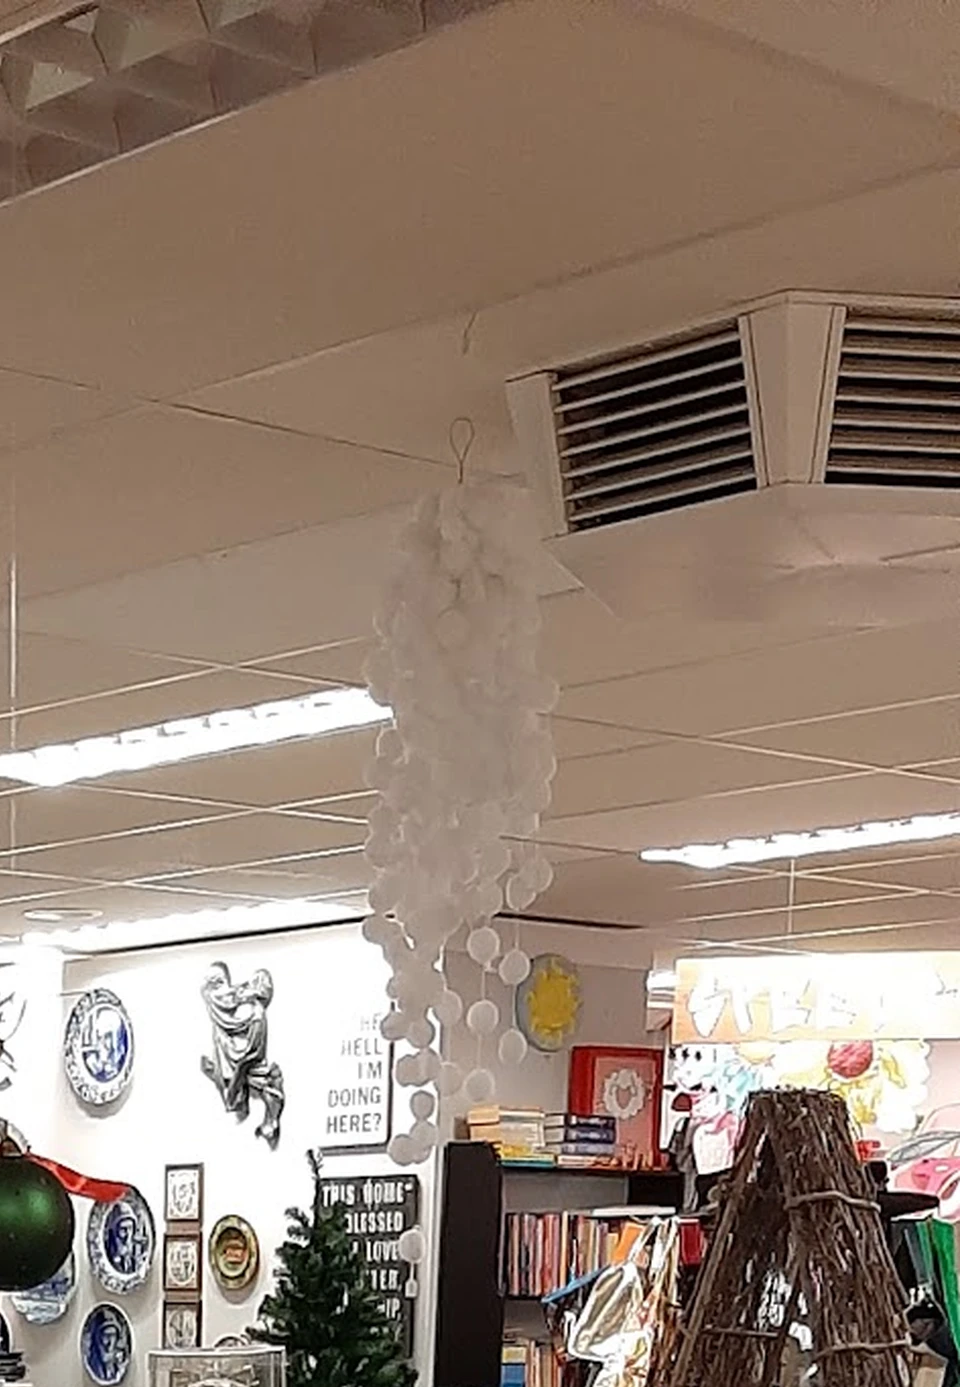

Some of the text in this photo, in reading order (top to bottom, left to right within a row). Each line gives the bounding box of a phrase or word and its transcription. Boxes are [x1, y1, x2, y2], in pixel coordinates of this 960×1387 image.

[341, 1037, 383, 1056] HELL
[327, 1086, 382, 1108] DOING
[325, 1112, 382, 1134] HERE?
[322, 1183, 355, 1207] THIS
